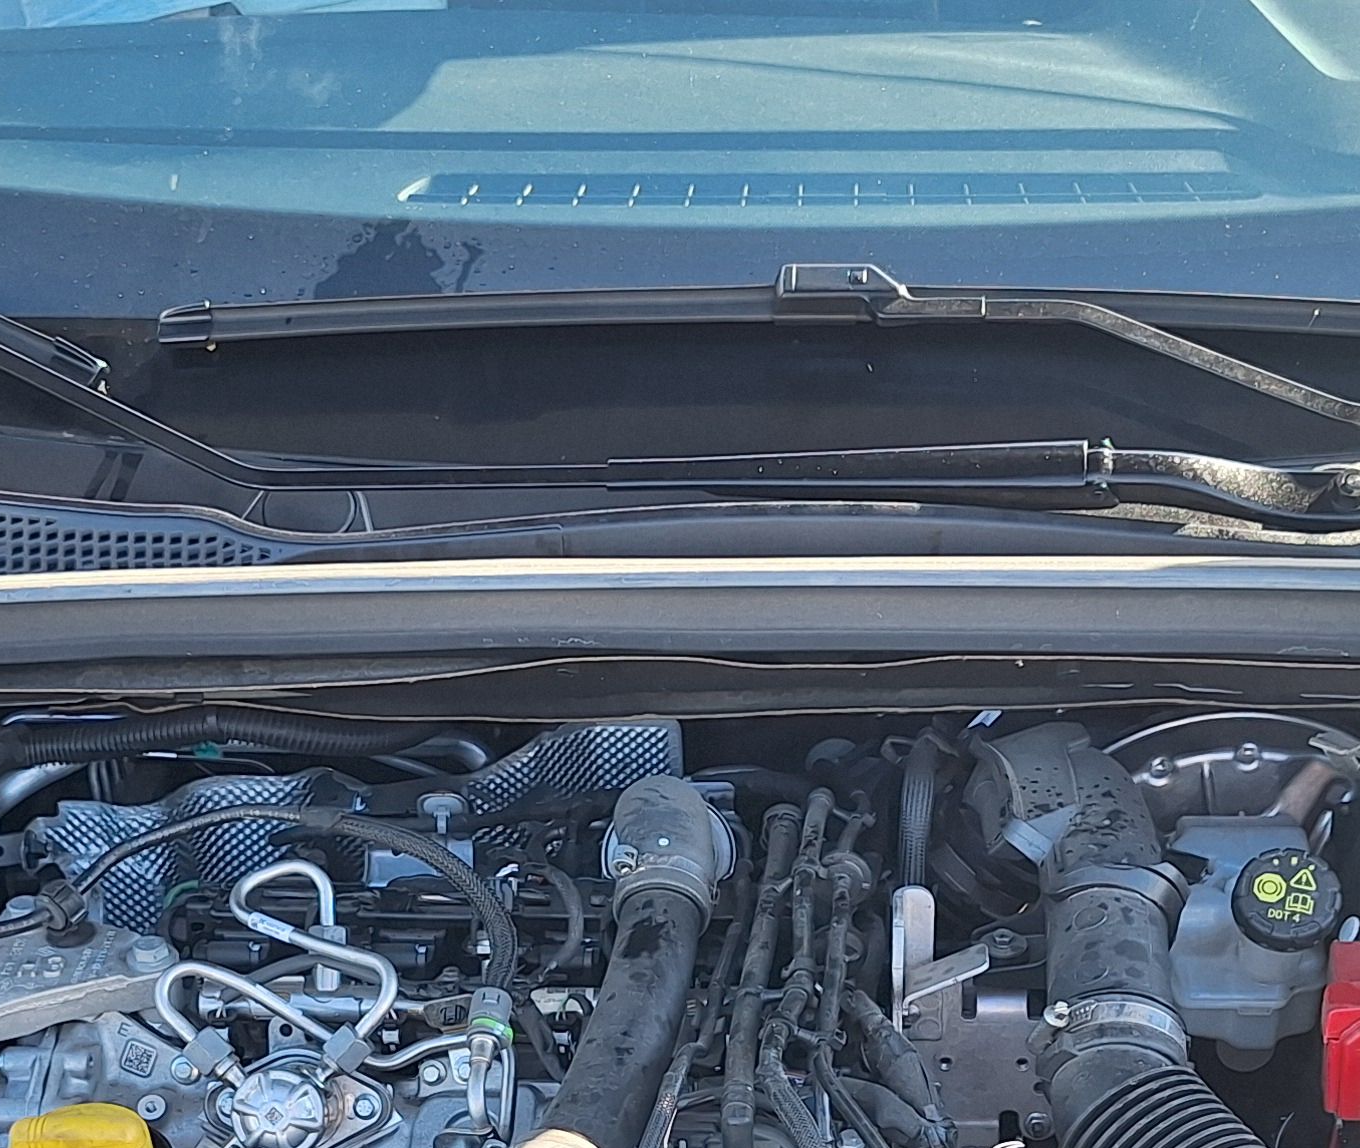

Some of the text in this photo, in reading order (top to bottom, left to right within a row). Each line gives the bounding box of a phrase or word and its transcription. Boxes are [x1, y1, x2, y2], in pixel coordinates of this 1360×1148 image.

[1267, 908, 1300, 922] DOT 4
[117, 1022, 133, 1037] E
